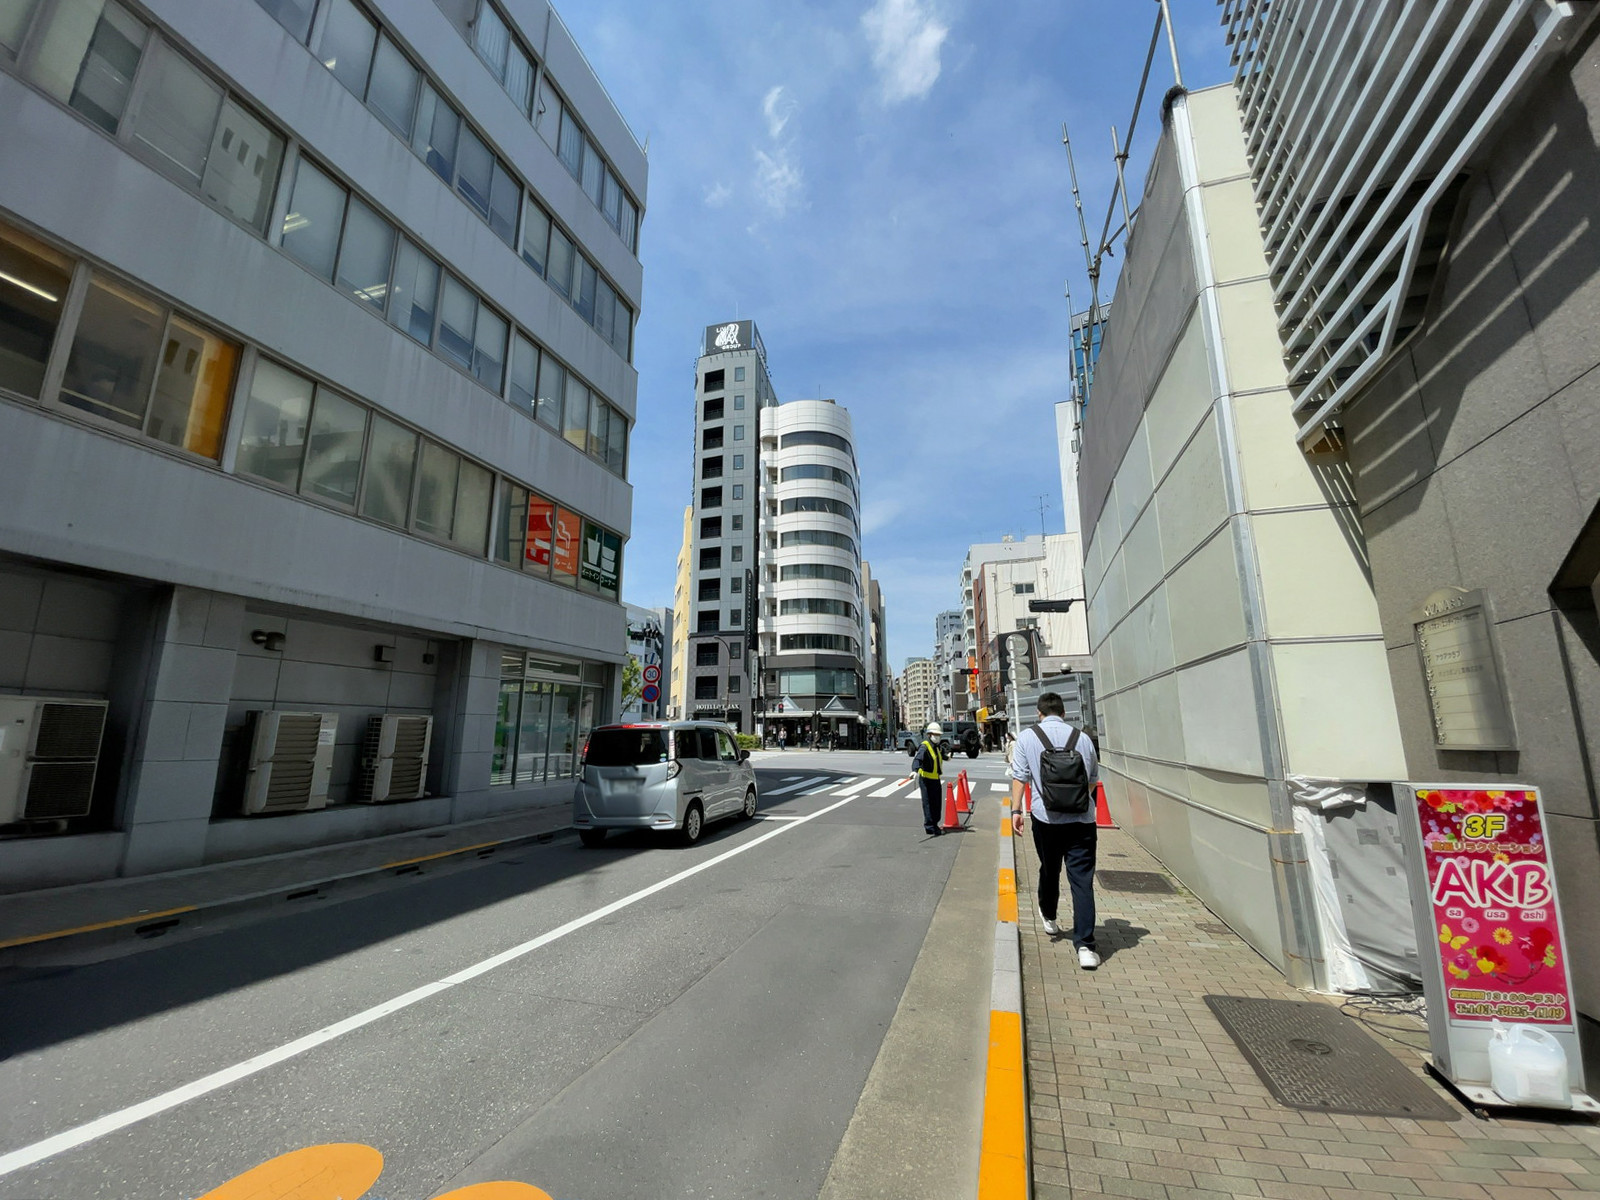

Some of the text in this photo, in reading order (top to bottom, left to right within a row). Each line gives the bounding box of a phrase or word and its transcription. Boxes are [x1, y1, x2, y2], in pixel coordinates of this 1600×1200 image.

[647, 670, 657, 679] 30
[1464, 815, 1505, 838] 3F
[1433, 859, 1551, 908] AKB
[1448, 908, 1545, 920] sa usa ashi
